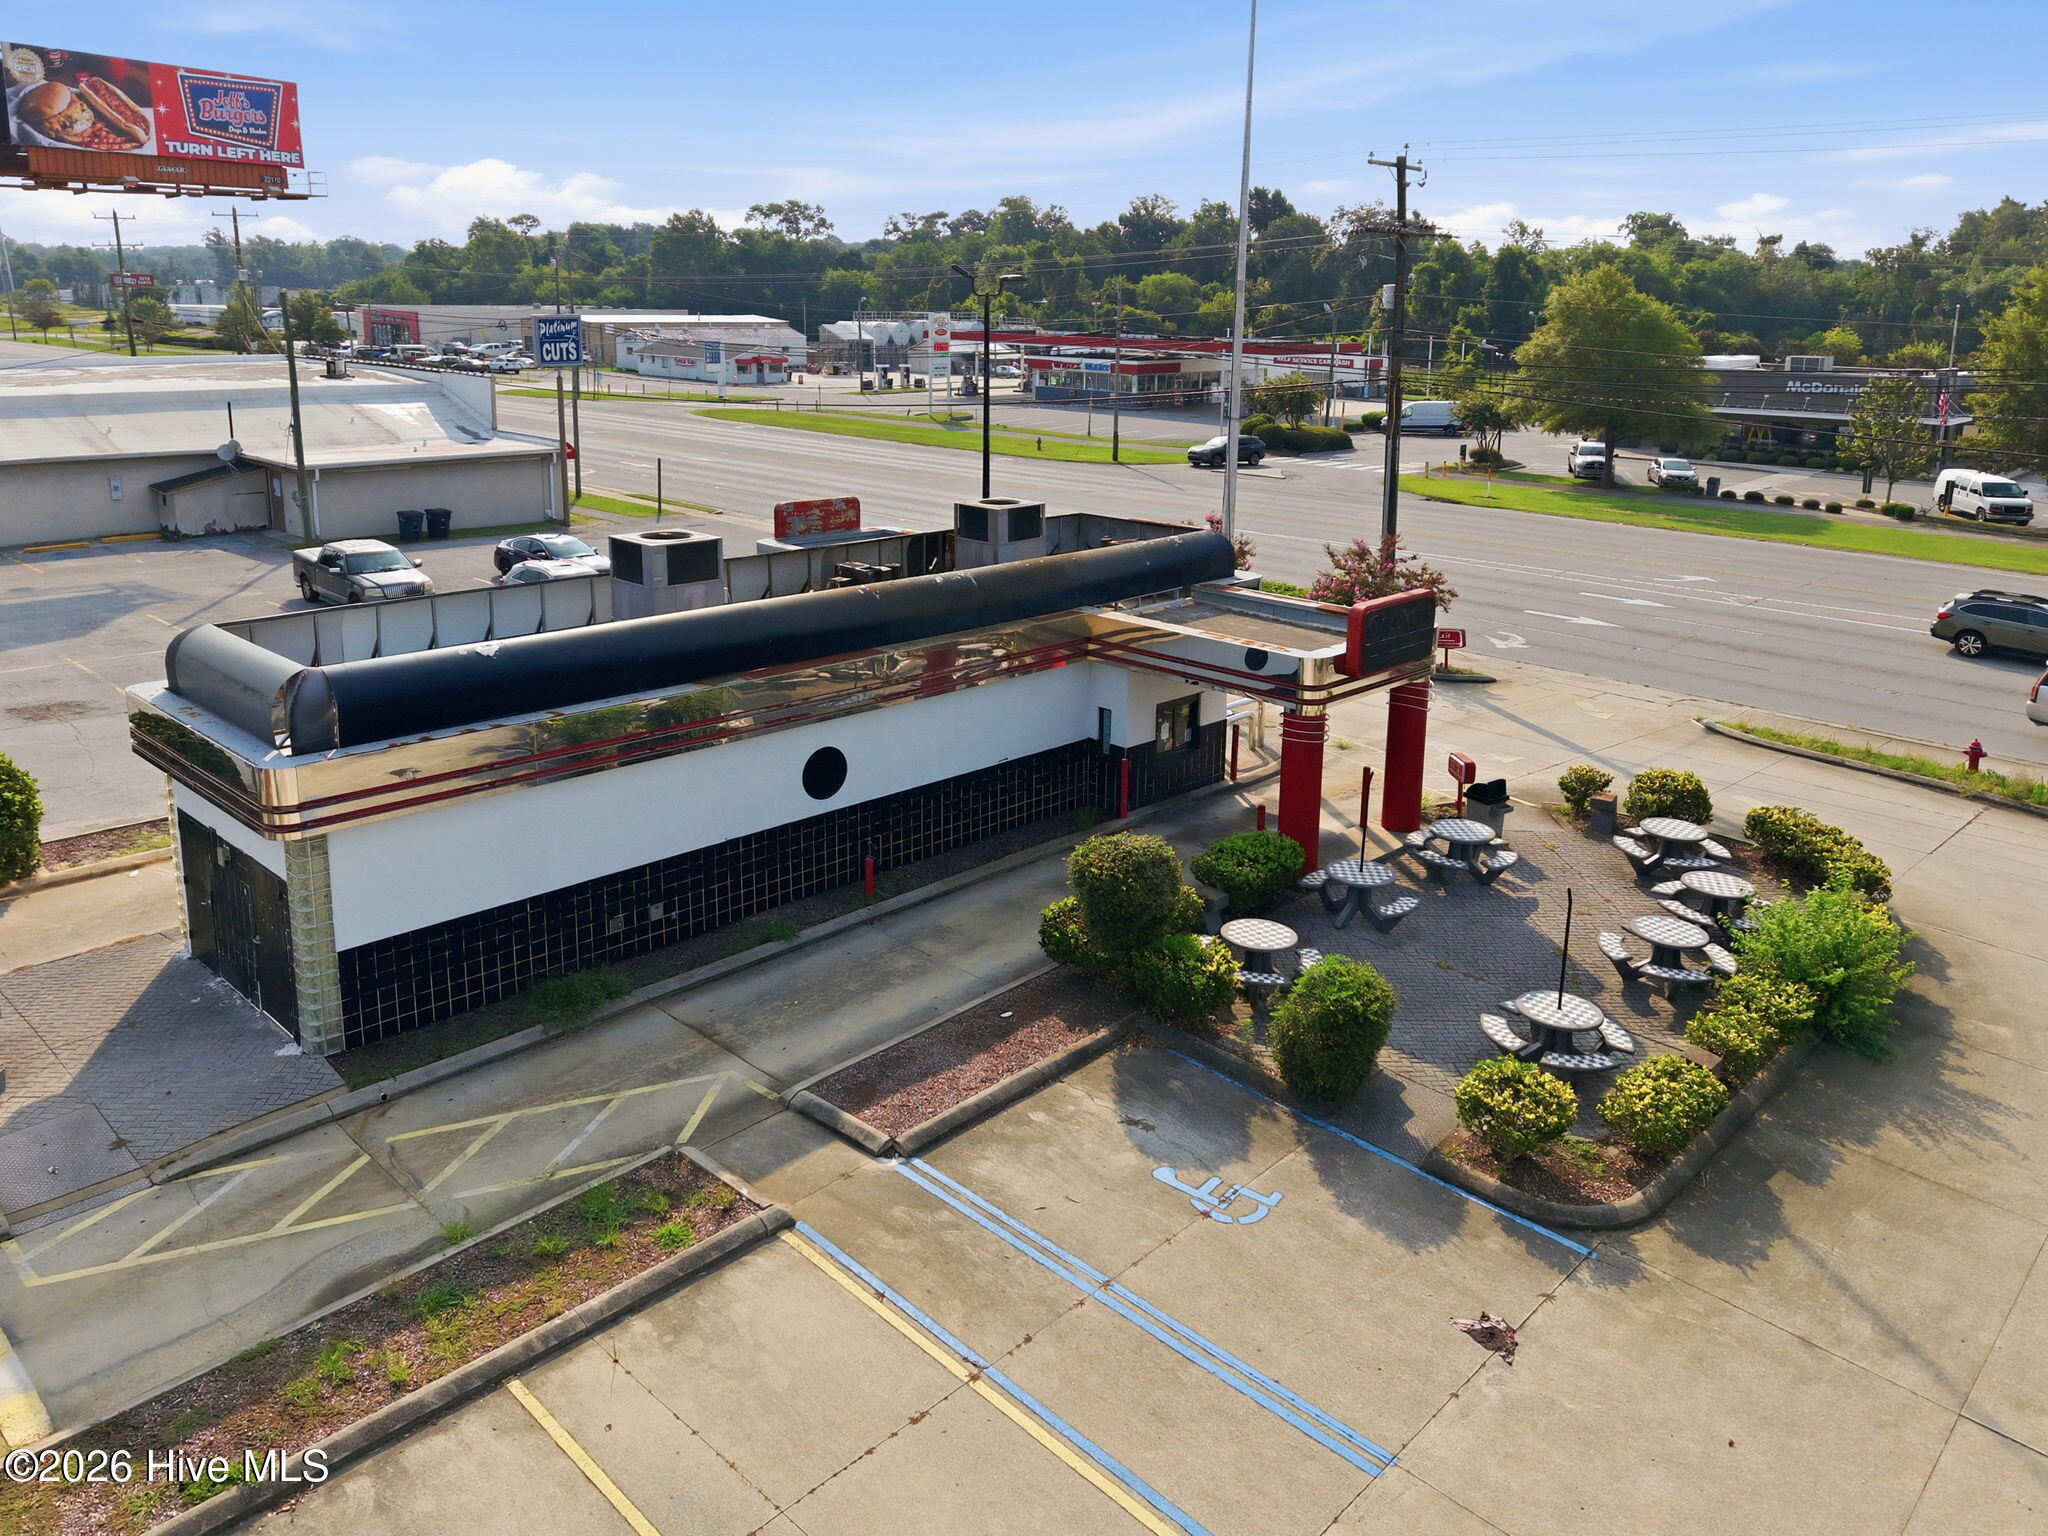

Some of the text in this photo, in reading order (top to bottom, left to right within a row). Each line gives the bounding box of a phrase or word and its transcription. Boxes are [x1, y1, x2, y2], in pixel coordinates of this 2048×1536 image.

[213, 89, 250, 109] Jeff's
[198, 98, 267, 127] Burgers
[164, 141, 301, 164] TURN LEFT HERE
[539, 319, 578, 338] Platinum
[542, 342, 577, 361] CUTS
